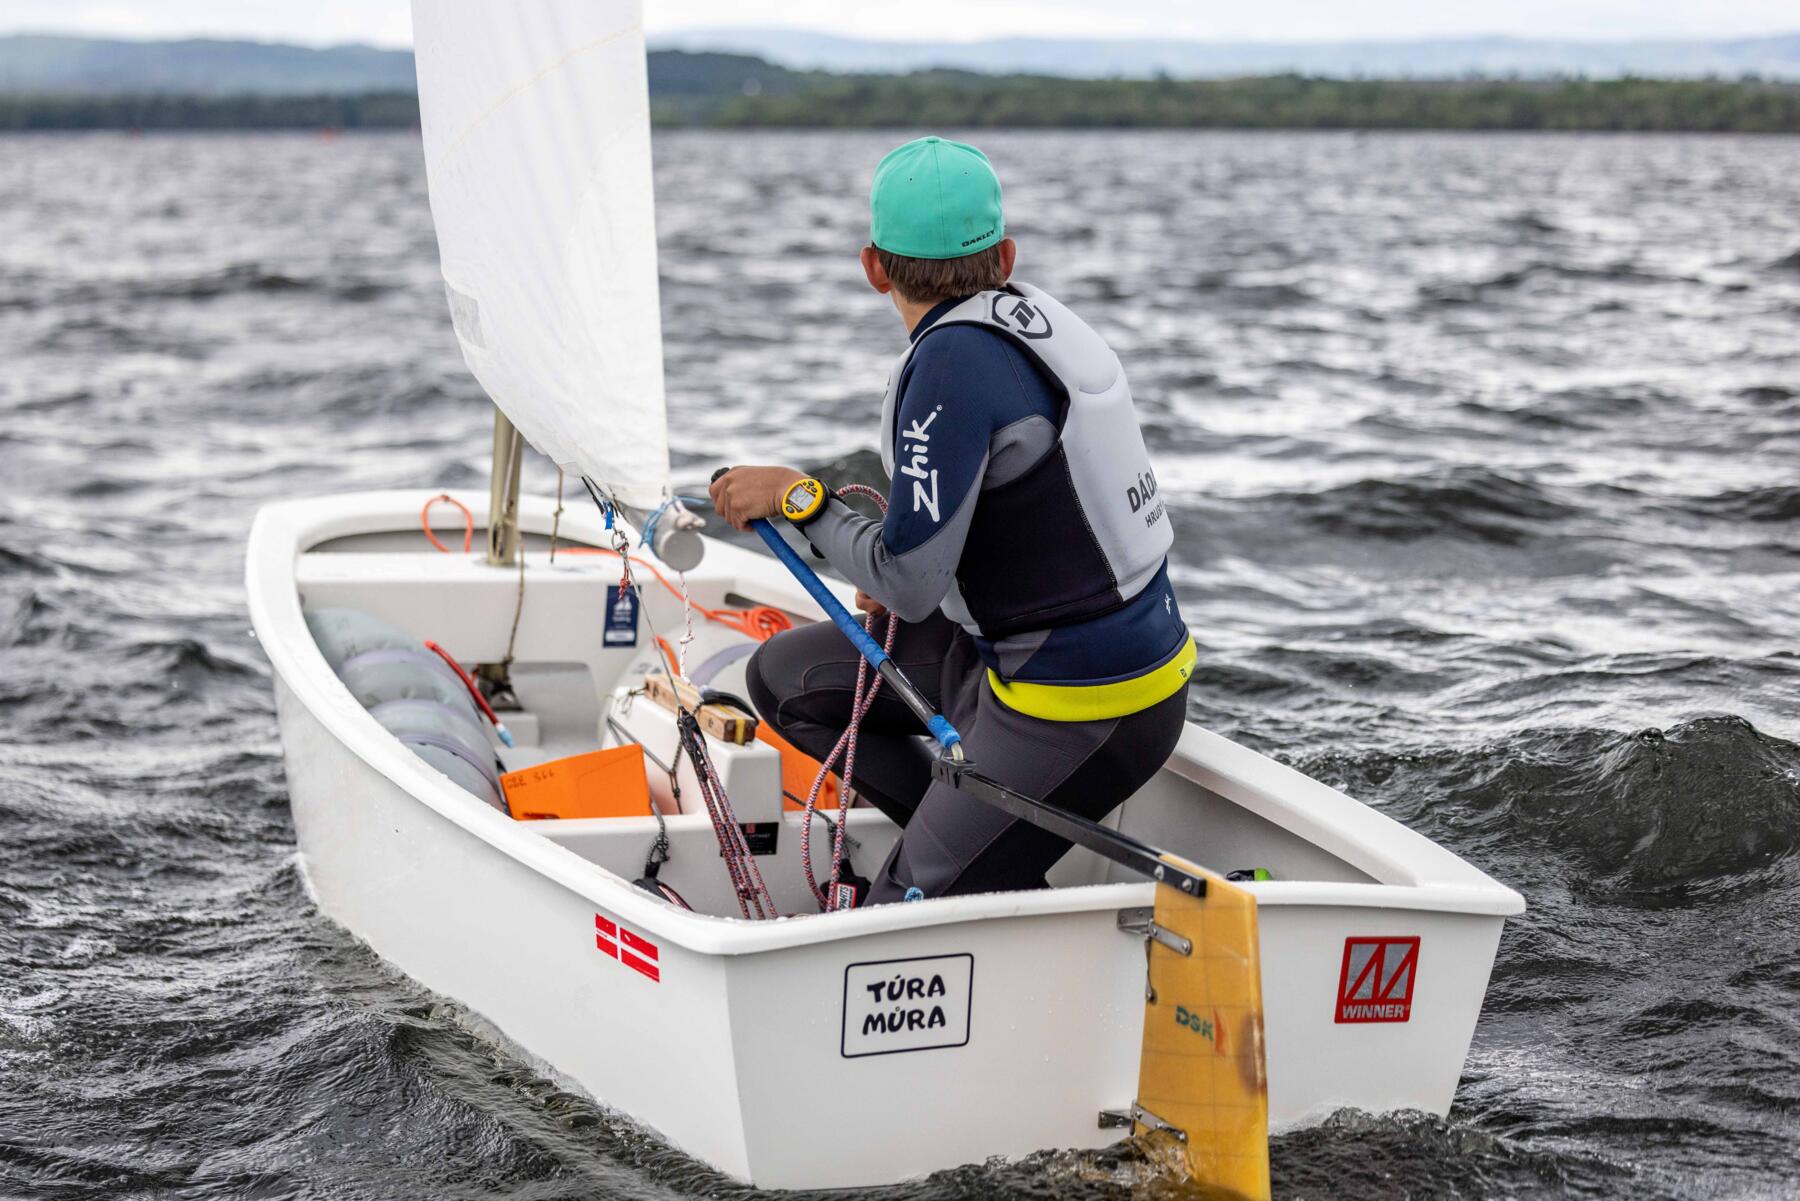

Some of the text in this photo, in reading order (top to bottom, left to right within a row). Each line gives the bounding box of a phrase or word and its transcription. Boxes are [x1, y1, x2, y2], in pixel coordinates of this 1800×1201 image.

[962, 229, 995, 247] OAKLEY
[901, 411, 940, 522] Zhik
[867, 974, 946, 1003] TÚRA
[862, 1005, 946, 1036] MŮRA
[1176, 1005, 1214, 1041] DSK
[1342, 1004, 1405, 1019] WINNER
